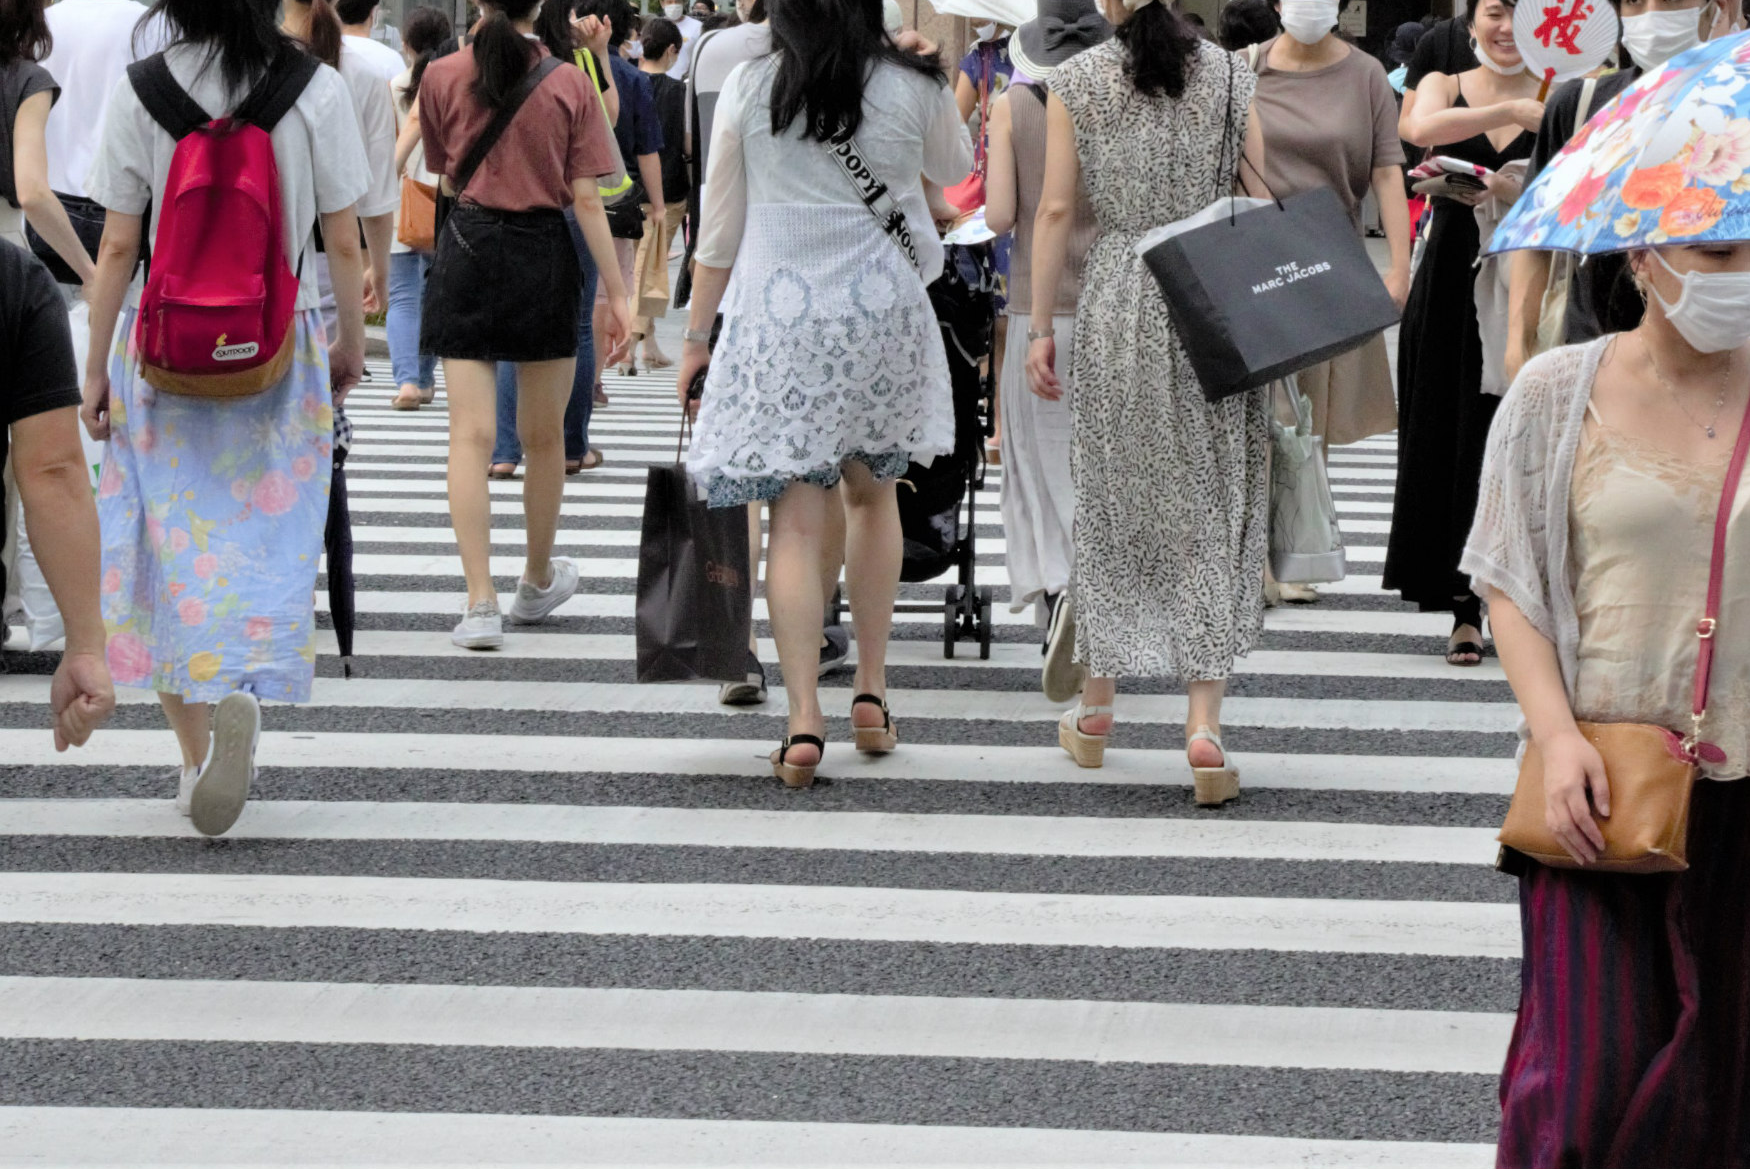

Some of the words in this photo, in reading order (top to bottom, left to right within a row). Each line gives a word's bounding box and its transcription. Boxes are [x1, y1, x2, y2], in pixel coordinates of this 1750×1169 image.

[1275, 261, 1300, 277] THE
[1251, 277, 1286, 295] MARC
[1286, 260, 1332, 284] JACOBS
[215, 345, 256, 358] OUTDOOR
